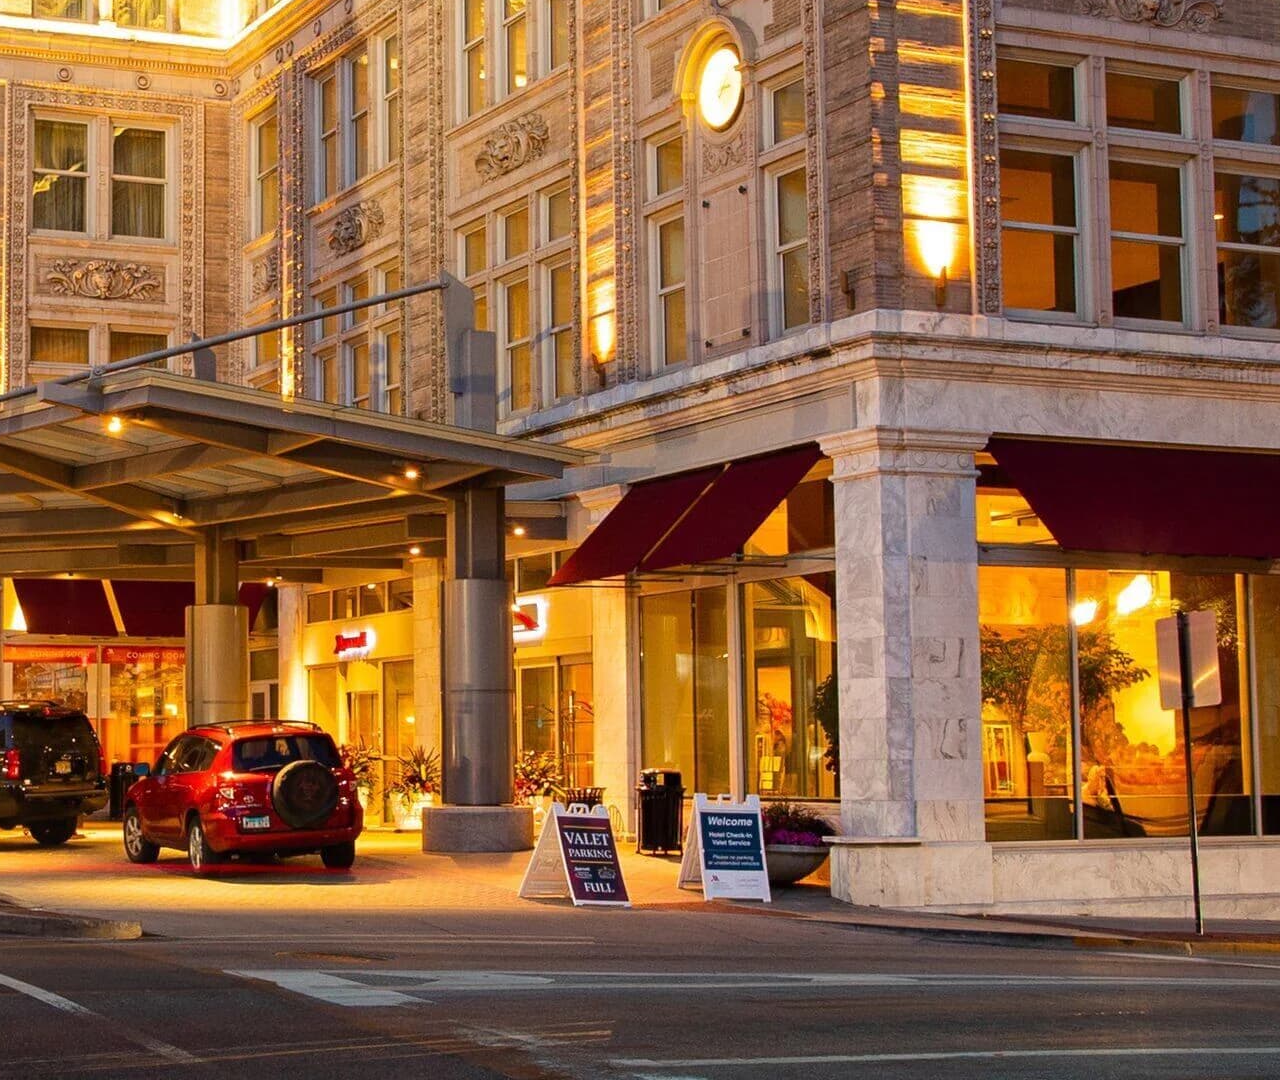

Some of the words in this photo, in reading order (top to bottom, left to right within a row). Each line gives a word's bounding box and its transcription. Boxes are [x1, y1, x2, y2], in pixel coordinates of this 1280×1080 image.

[126, 651, 160, 660] COMING
[163, 651, 185, 660] SOON
[707, 816, 753, 827] Welcome
[563, 831, 609, 847] VALET
[568, 848, 612, 859] PARKING
[584, 882, 615, 894] FULL
